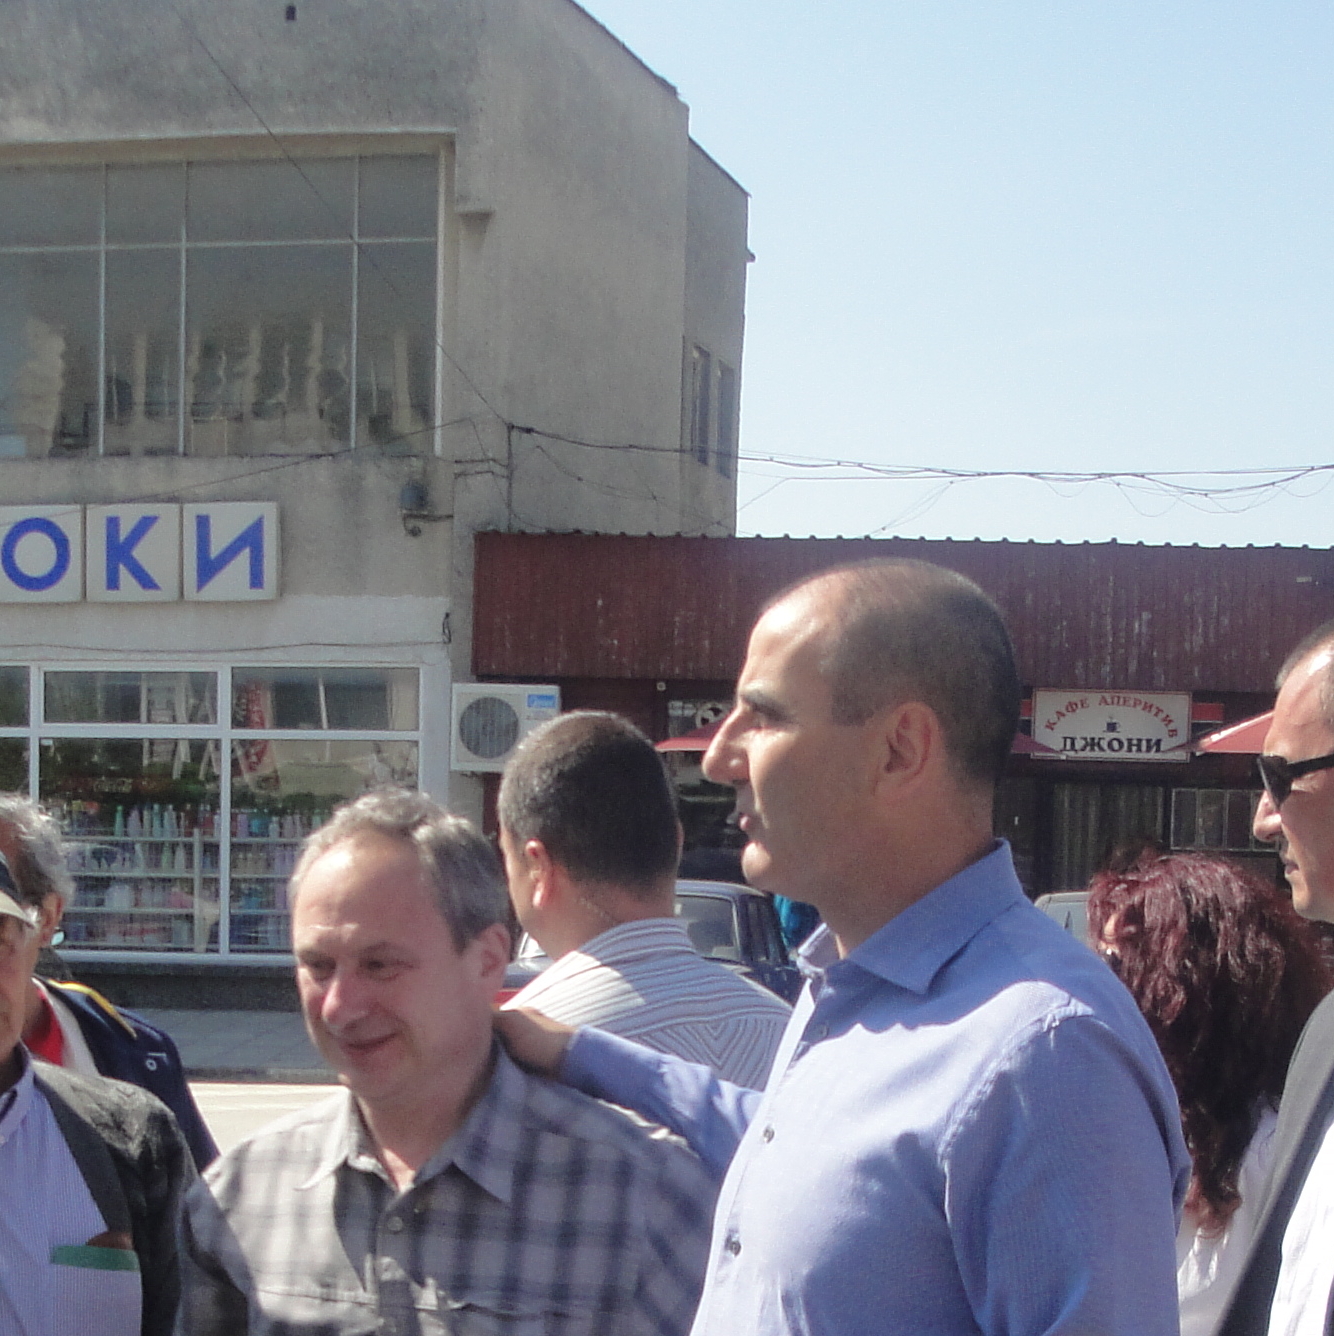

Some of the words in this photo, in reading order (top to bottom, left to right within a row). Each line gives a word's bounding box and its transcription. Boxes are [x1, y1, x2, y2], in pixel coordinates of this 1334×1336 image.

[1044, 697, 1090, 732] КАФЕ
[1098, 694, 1178, 738] АПЕРИТИВ
[1060, 736, 1163, 755] ДЖОНИ
